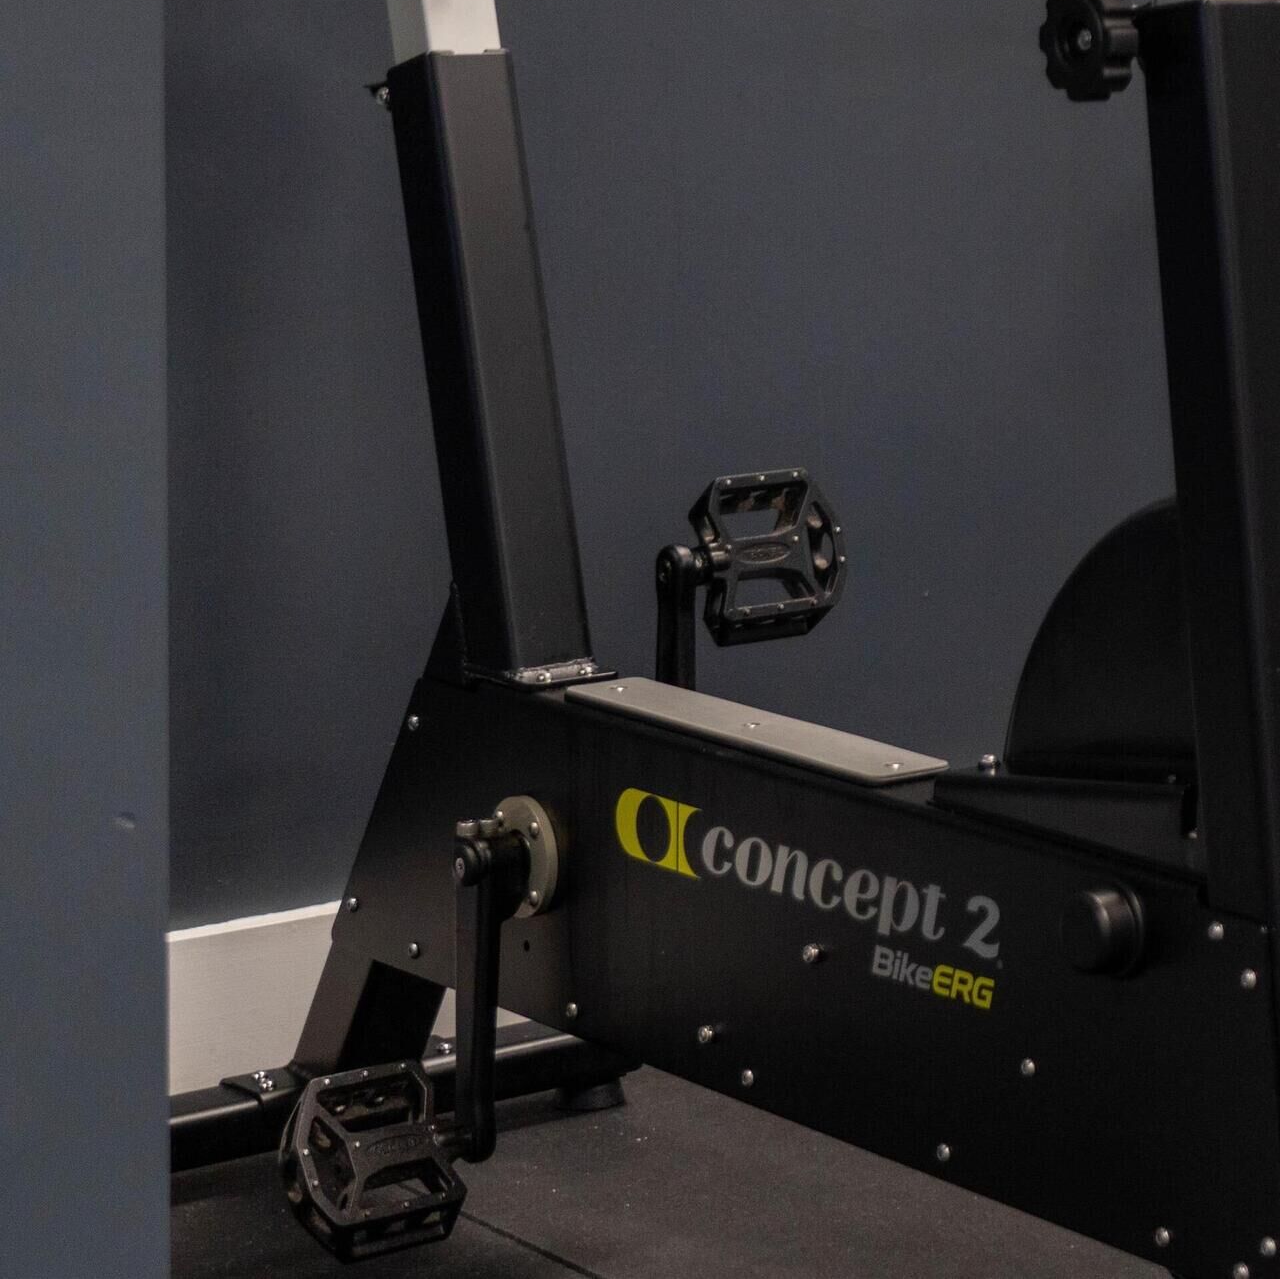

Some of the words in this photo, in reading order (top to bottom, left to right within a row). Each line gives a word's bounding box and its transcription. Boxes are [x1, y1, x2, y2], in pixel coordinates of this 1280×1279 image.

[701, 824, 947, 943] concept
[962, 894, 1001, 959] 2
[870, 943, 996, 1011] BikeERG
